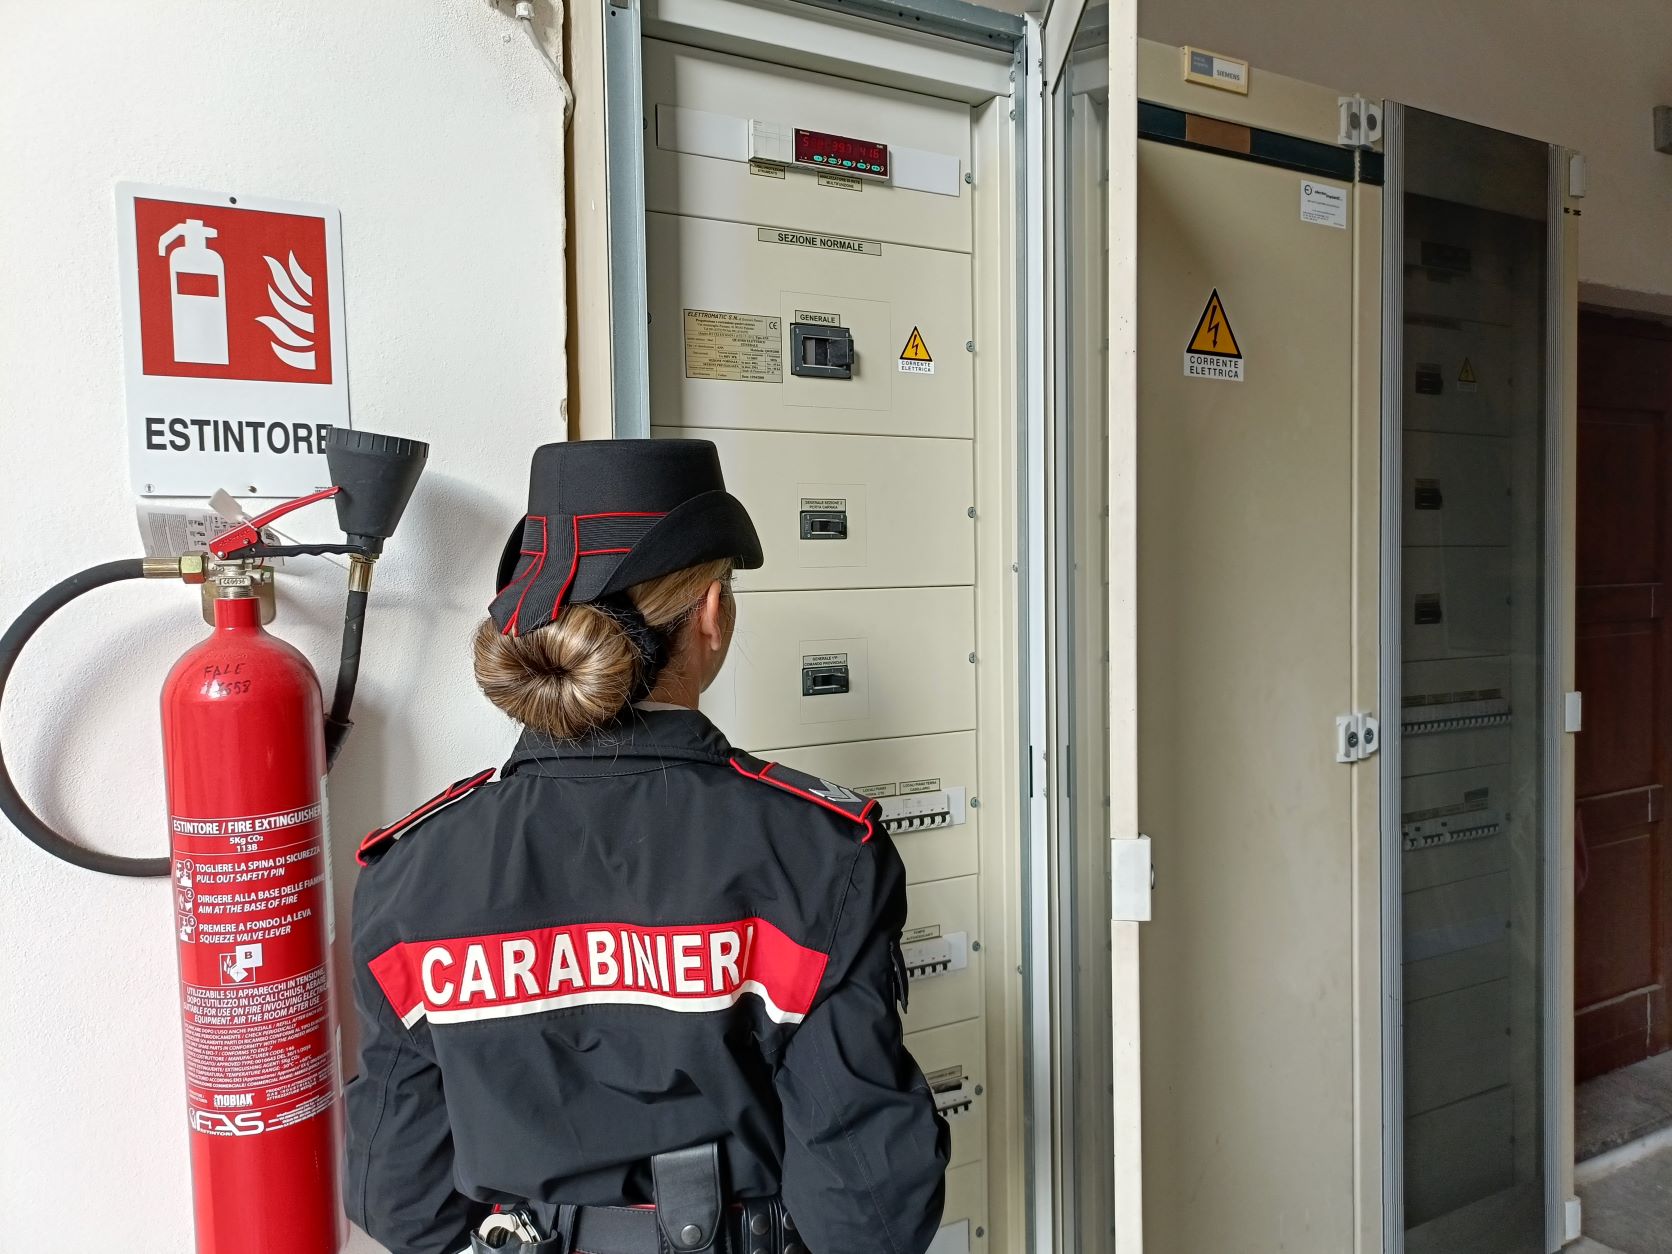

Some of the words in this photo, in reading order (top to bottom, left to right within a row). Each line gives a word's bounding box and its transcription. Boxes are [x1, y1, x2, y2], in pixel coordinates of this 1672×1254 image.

[1216, 70, 1240, 80] SIEMENS
[778, 232, 818, 246] SEZIONE
[820, 238, 864, 252] NORMALE
[688, 312, 728, 320] ELETTROMATIC
[800, 314, 836, 324] GENERALE
[901, 360, 930, 368] CORRENTE
[1190, 356, 1239, 368] CORRENTE
[1190, 366, 1238, 378] ELETTRICA
[145, 417, 333, 454] ESTINTORE
[174, 820, 219, 834] ESTINTORE
[228, 820, 252, 834] FIRE
[255, 804, 321, 830] EXTINGUISHER
[236, 844, 258, 852] 113B
[196, 864, 233, 872] TOGLIERE
[235, 863, 246, 872] LA
[248, 859, 275, 870] SPINA
[276, 857, 284, 866] DI
[286, 846, 320, 864] SICUREZZA
[196, 874, 216, 883] PULL
[216, 874, 235, 882] OUT
[236, 870, 270, 882] SAFETY
[270, 867, 286, 878] PIN
[198, 894, 232, 903] DIRIGERE
[234, 892, 256, 902] ALLA
[258, 888, 280, 899] BASE
[281, 882, 304, 896] DELLE
[198, 906, 213, 914] AIM
[214, 906, 224, 914] AT
[226, 904, 242, 913] THE
[244, 902, 266, 912] BASE
[268, 899, 280, 908] OF
[281, 894, 298, 906] FIRE
[199, 924, 236, 932] PREMERE
[238, 923, 244, 932] A
[246, 918, 280, 930] FONDO
[282, 914, 292, 924] LA
[294, 908, 312, 920] LEVA
[200, 934, 234, 944] SQUEEZE
[236, 930, 264, 942] VALVE
[265, 925, 291, 938] LEVER
[186, 986, 224, 998] UTILIZZABILE
[226, 990, 236, 998] SU
[238, 982, 286, 998] APPARECCHI
[288, 980, 296, 988] IN
[184, 1002, 204, 1014] SUITABLE
[204, 1008, 216, 1016] FOR
[218, 1008, 230, 1016] USE
[232, 1008, 244, 1016] ON
[244, 1005, 262, 1014] FIRE
[262, 995, 303, 1012] INVOLVING
[186, 996, 201, 1006] DOPO
[202, 999, 238, 1008] L'UTILIZZO
[240, 998, 248, 1006] IN
[250, 993, 278, 1004] LOCALI
[194, 1014, 232, 1024] EQUIPMENT.
[233, 1016, 246, 1024] AIR
[248, 1013, 262, 1022] THE
[264, 1008, 288, 1021] ROOM
[288, 1000, 309, 1014] AFTER
[310, 996, 320, 1006] USE
